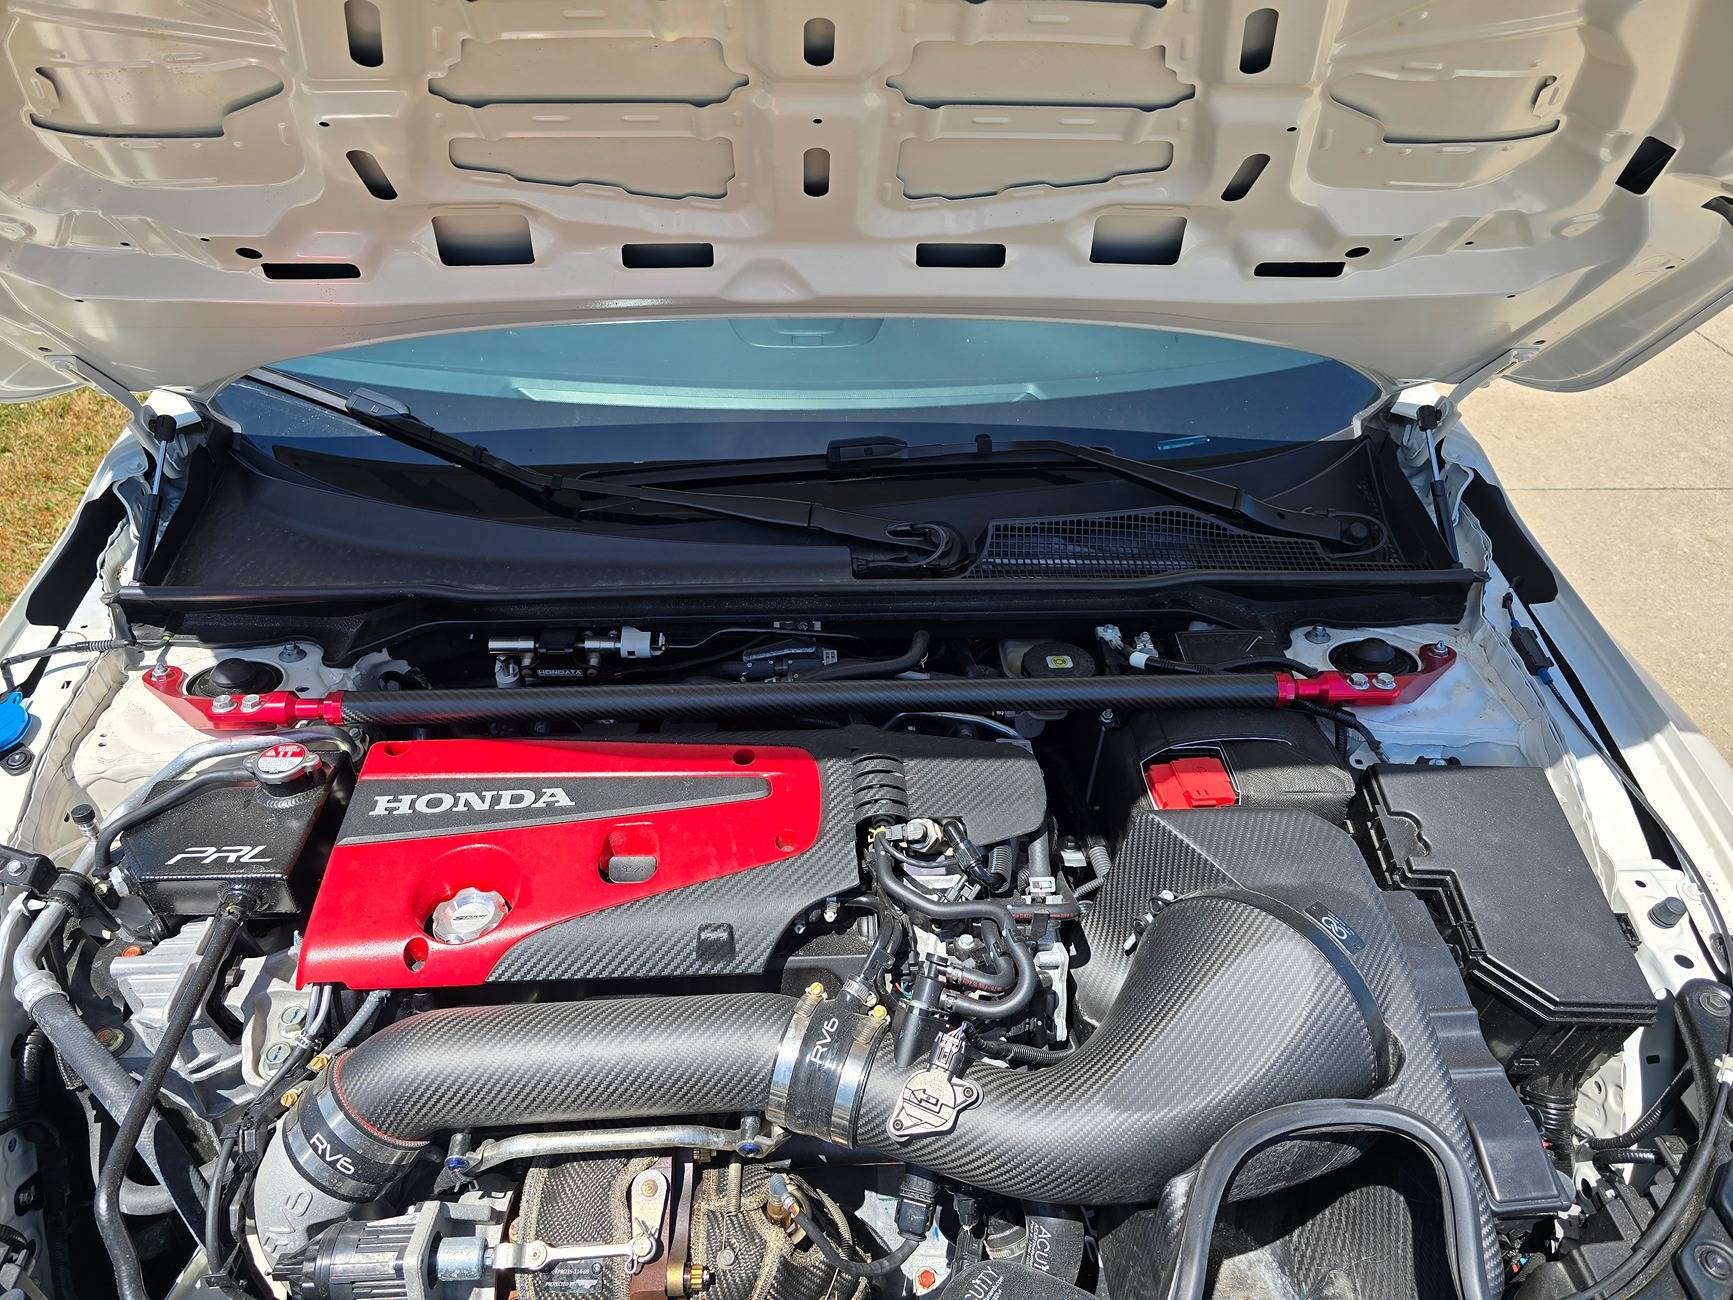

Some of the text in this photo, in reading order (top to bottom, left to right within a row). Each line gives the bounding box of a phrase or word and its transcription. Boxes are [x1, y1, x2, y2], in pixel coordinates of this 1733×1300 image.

[537, 669, 583, 677] HONDATA
[369, 787, 576, 816] HONDA
[165, 845, 273, 865] PRL
[810, 1017, 839, 1065] RV6
[309, 1132, 355, 1175] RV6
[1033, 1225, 1052, 1271] ACUI
